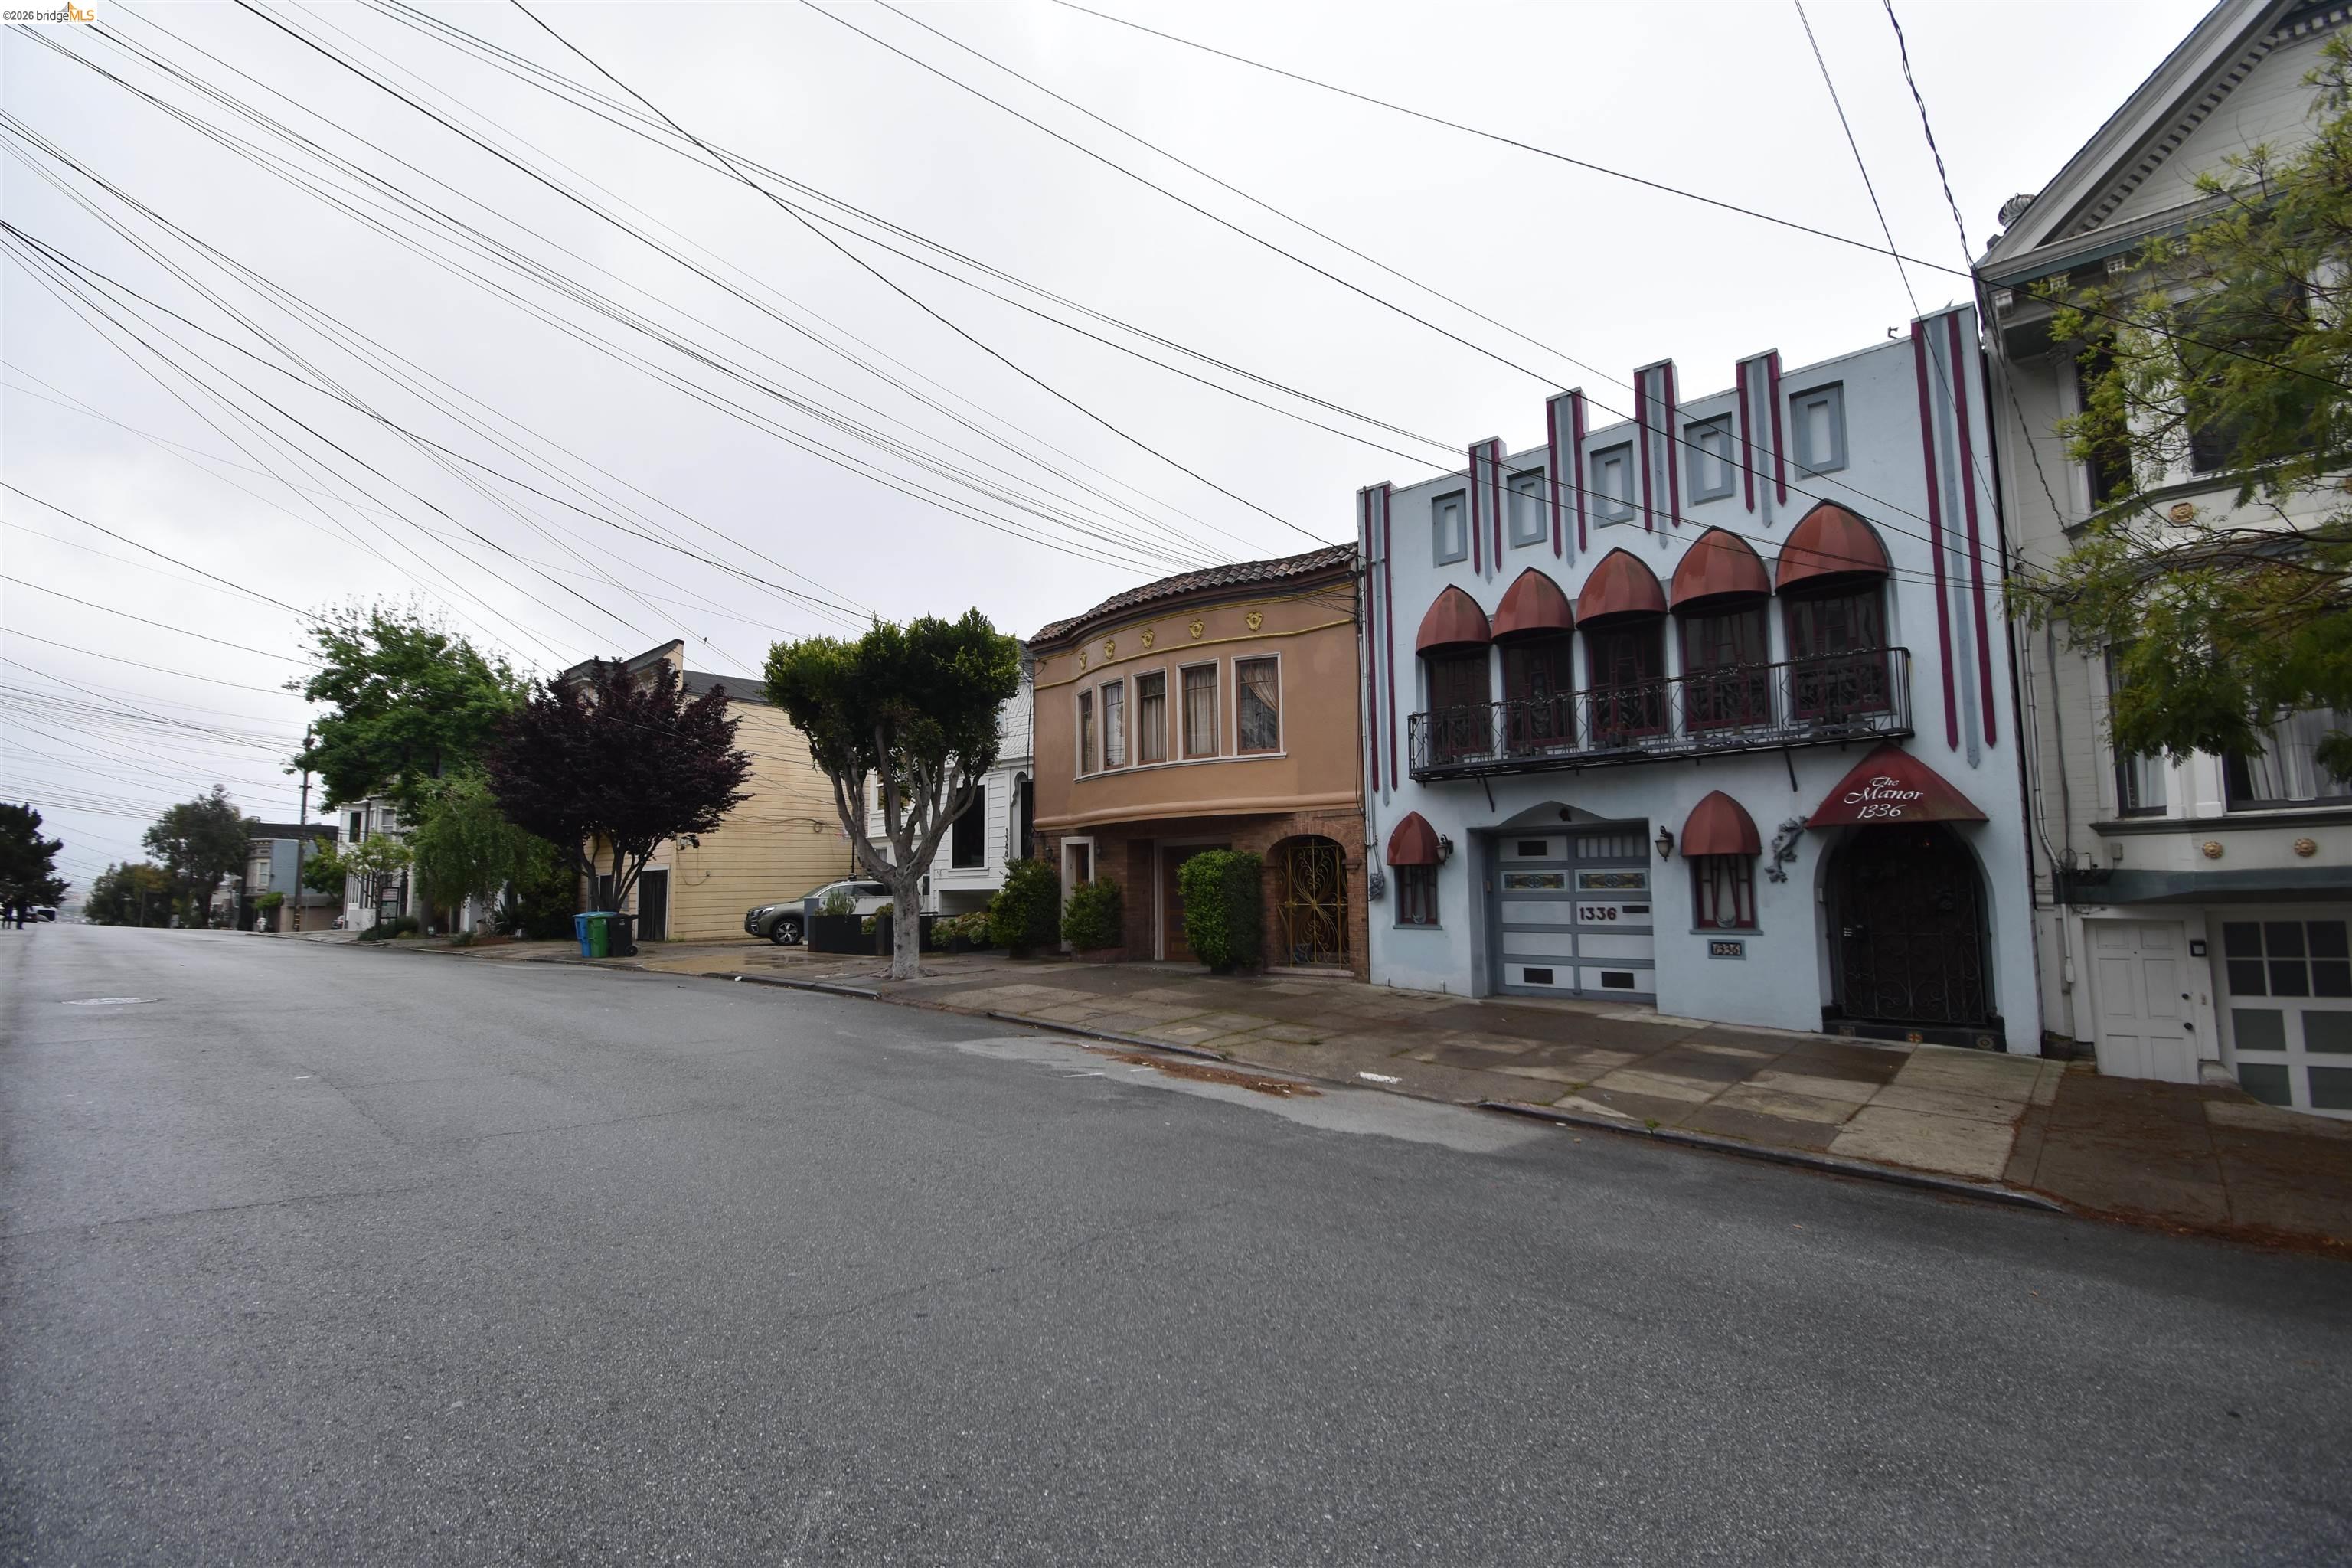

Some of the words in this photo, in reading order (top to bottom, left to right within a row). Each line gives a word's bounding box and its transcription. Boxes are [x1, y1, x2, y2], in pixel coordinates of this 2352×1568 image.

[1869, 776, 1900, 787] The
[1844, 785, 1923, 804] Manor
[1857, 803, 1906, 819] 1336
[1579, 906, 1618, 920] 1336
